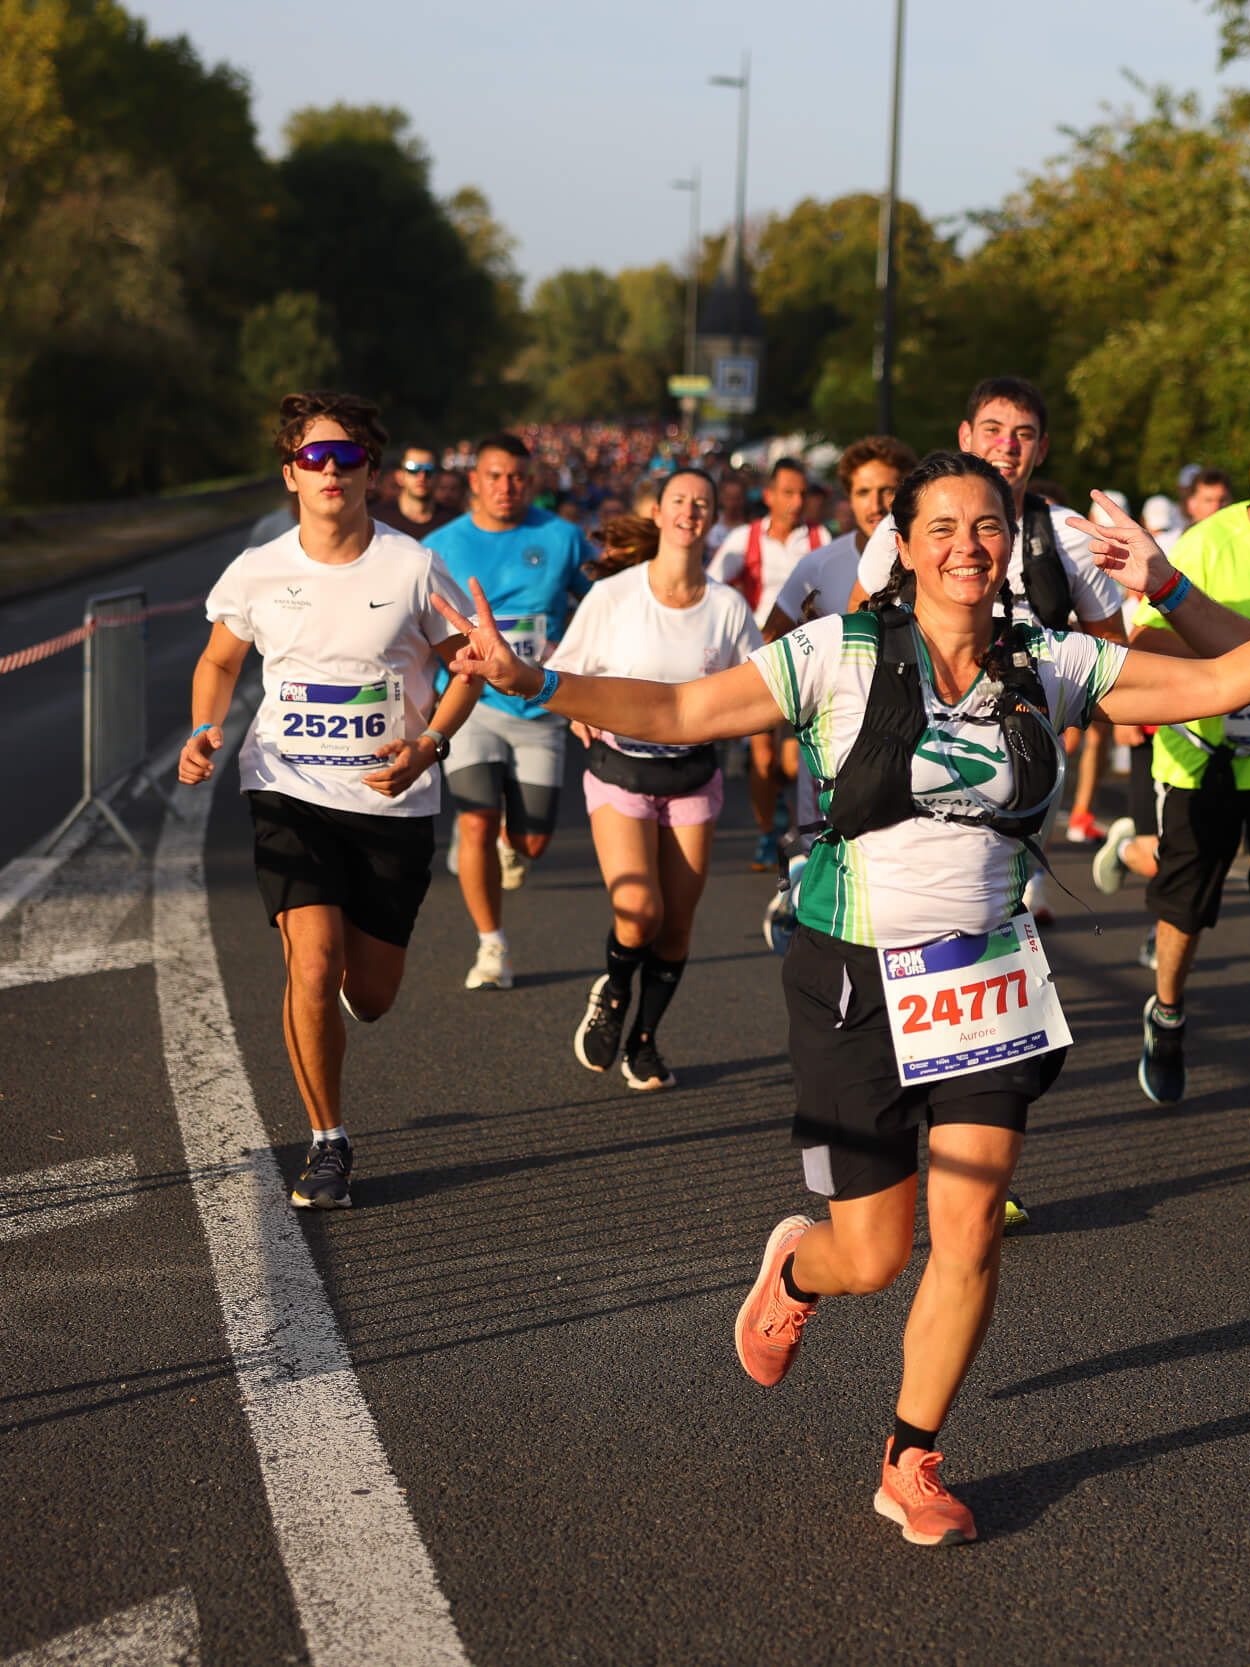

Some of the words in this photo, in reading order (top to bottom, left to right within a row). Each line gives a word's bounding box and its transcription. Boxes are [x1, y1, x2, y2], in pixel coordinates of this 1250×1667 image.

[283, 712, 386, 738] 25216
[887, 949, 924, 969] 20K
[888, 964, 926, 979] TOURS
[898, 969, 1028, 1034] 24777
[959, 1026, 997, 1042] Aurore
